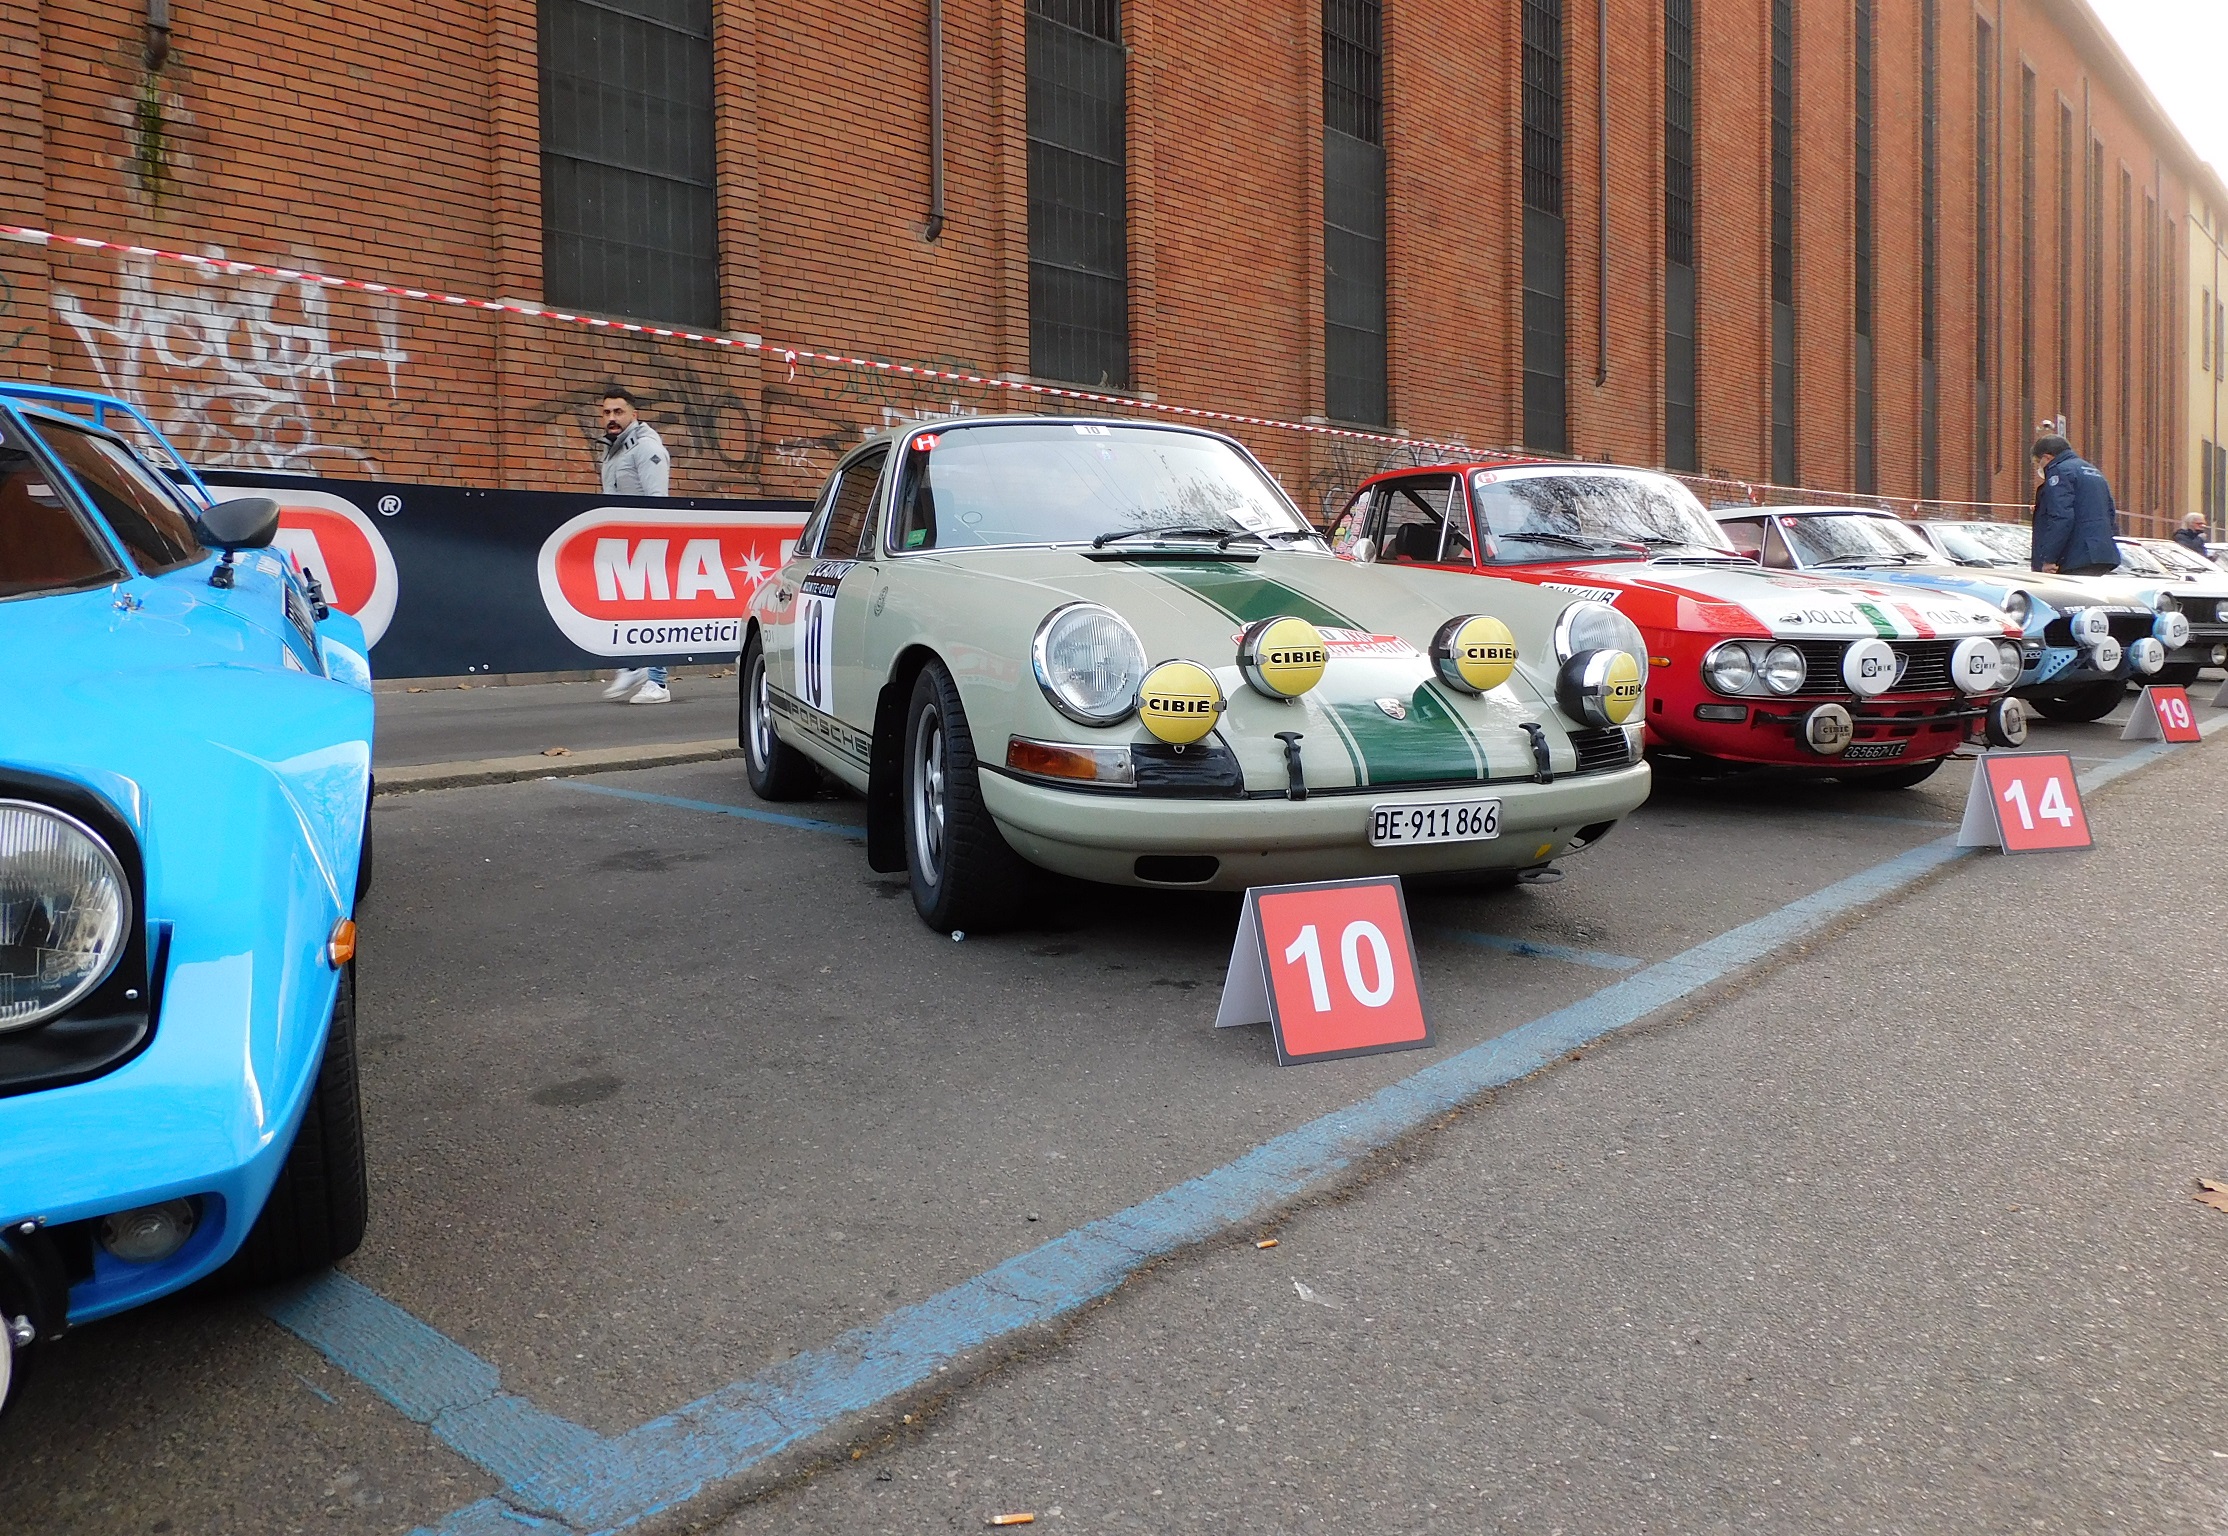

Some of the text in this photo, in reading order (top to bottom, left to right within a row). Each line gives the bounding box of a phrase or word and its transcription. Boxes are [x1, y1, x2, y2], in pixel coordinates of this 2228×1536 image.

[612, 623, 619, 645] i
[626, 620, 738, 644] cosmetici
[1802, 608, 1970, 626] JOLLY CLUB
[804, 599, 823, 709] 10
[790, 702, 869, 757] PORSCHE
[2159, 698, 2190, 730] 19
[2003, 777, 2074, 830] 14
[1285, 920, 1395, 1012] 10
